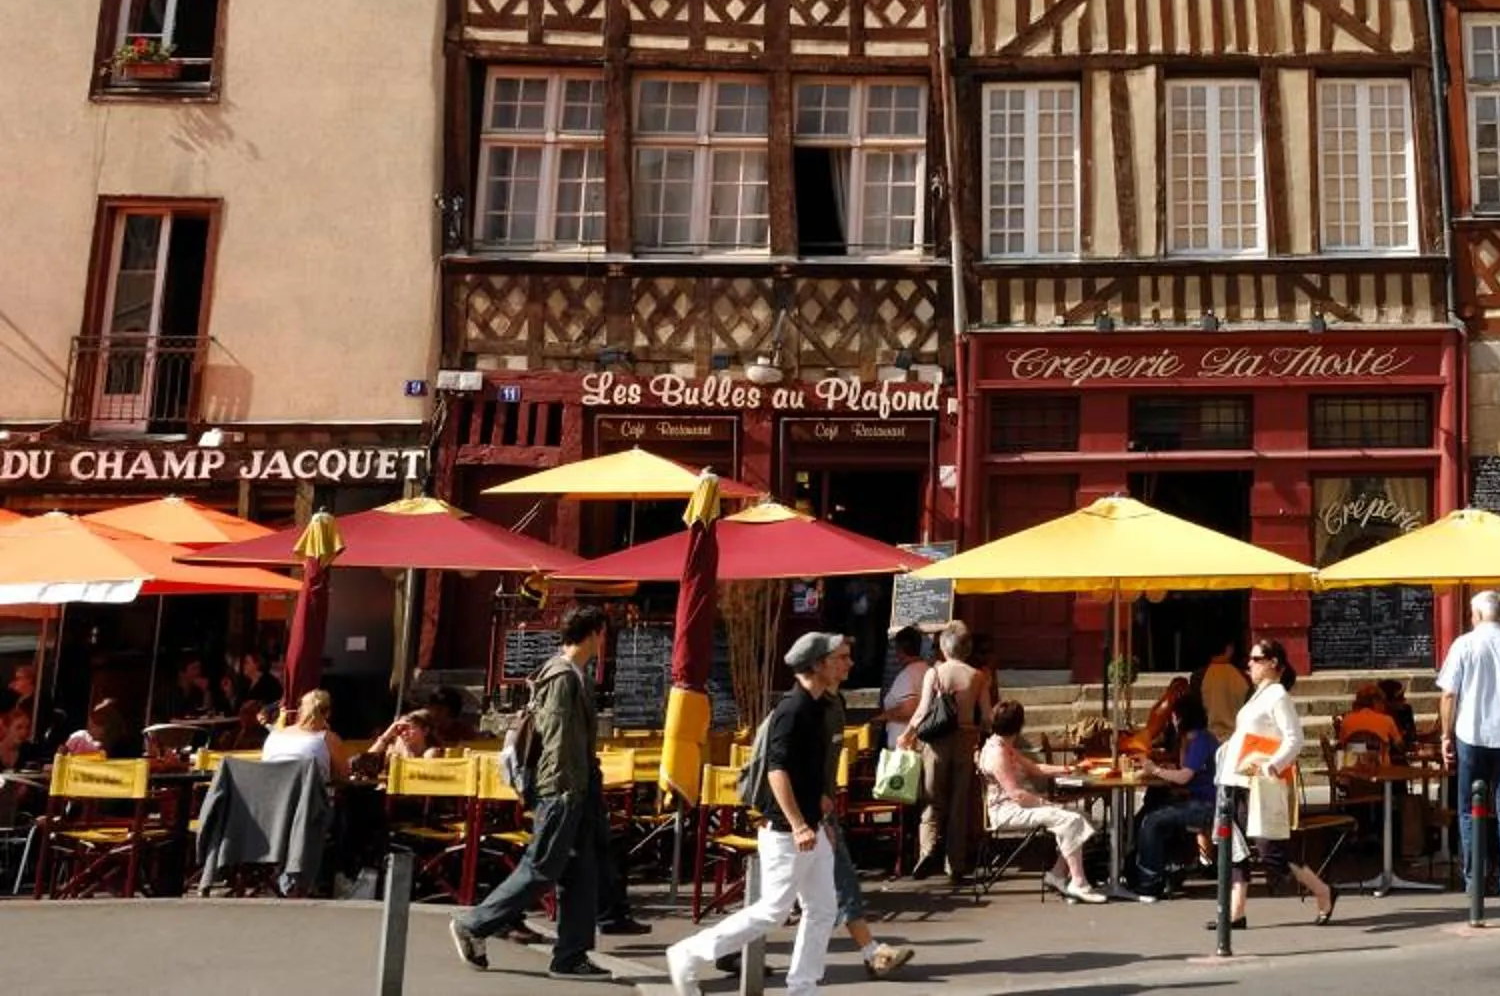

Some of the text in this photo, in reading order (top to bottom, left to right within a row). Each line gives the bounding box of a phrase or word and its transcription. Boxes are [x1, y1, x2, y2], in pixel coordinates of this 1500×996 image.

[1006, 346, 1413, 386] Crêperie La Thosté
[410, 381, 422, 395] 9
[502, 387, 517, 401] 11
[581, 371, 941, 419] Les Bulles au Plafond
[0, 449, 426, 481] DU CHAMP JACQUET
